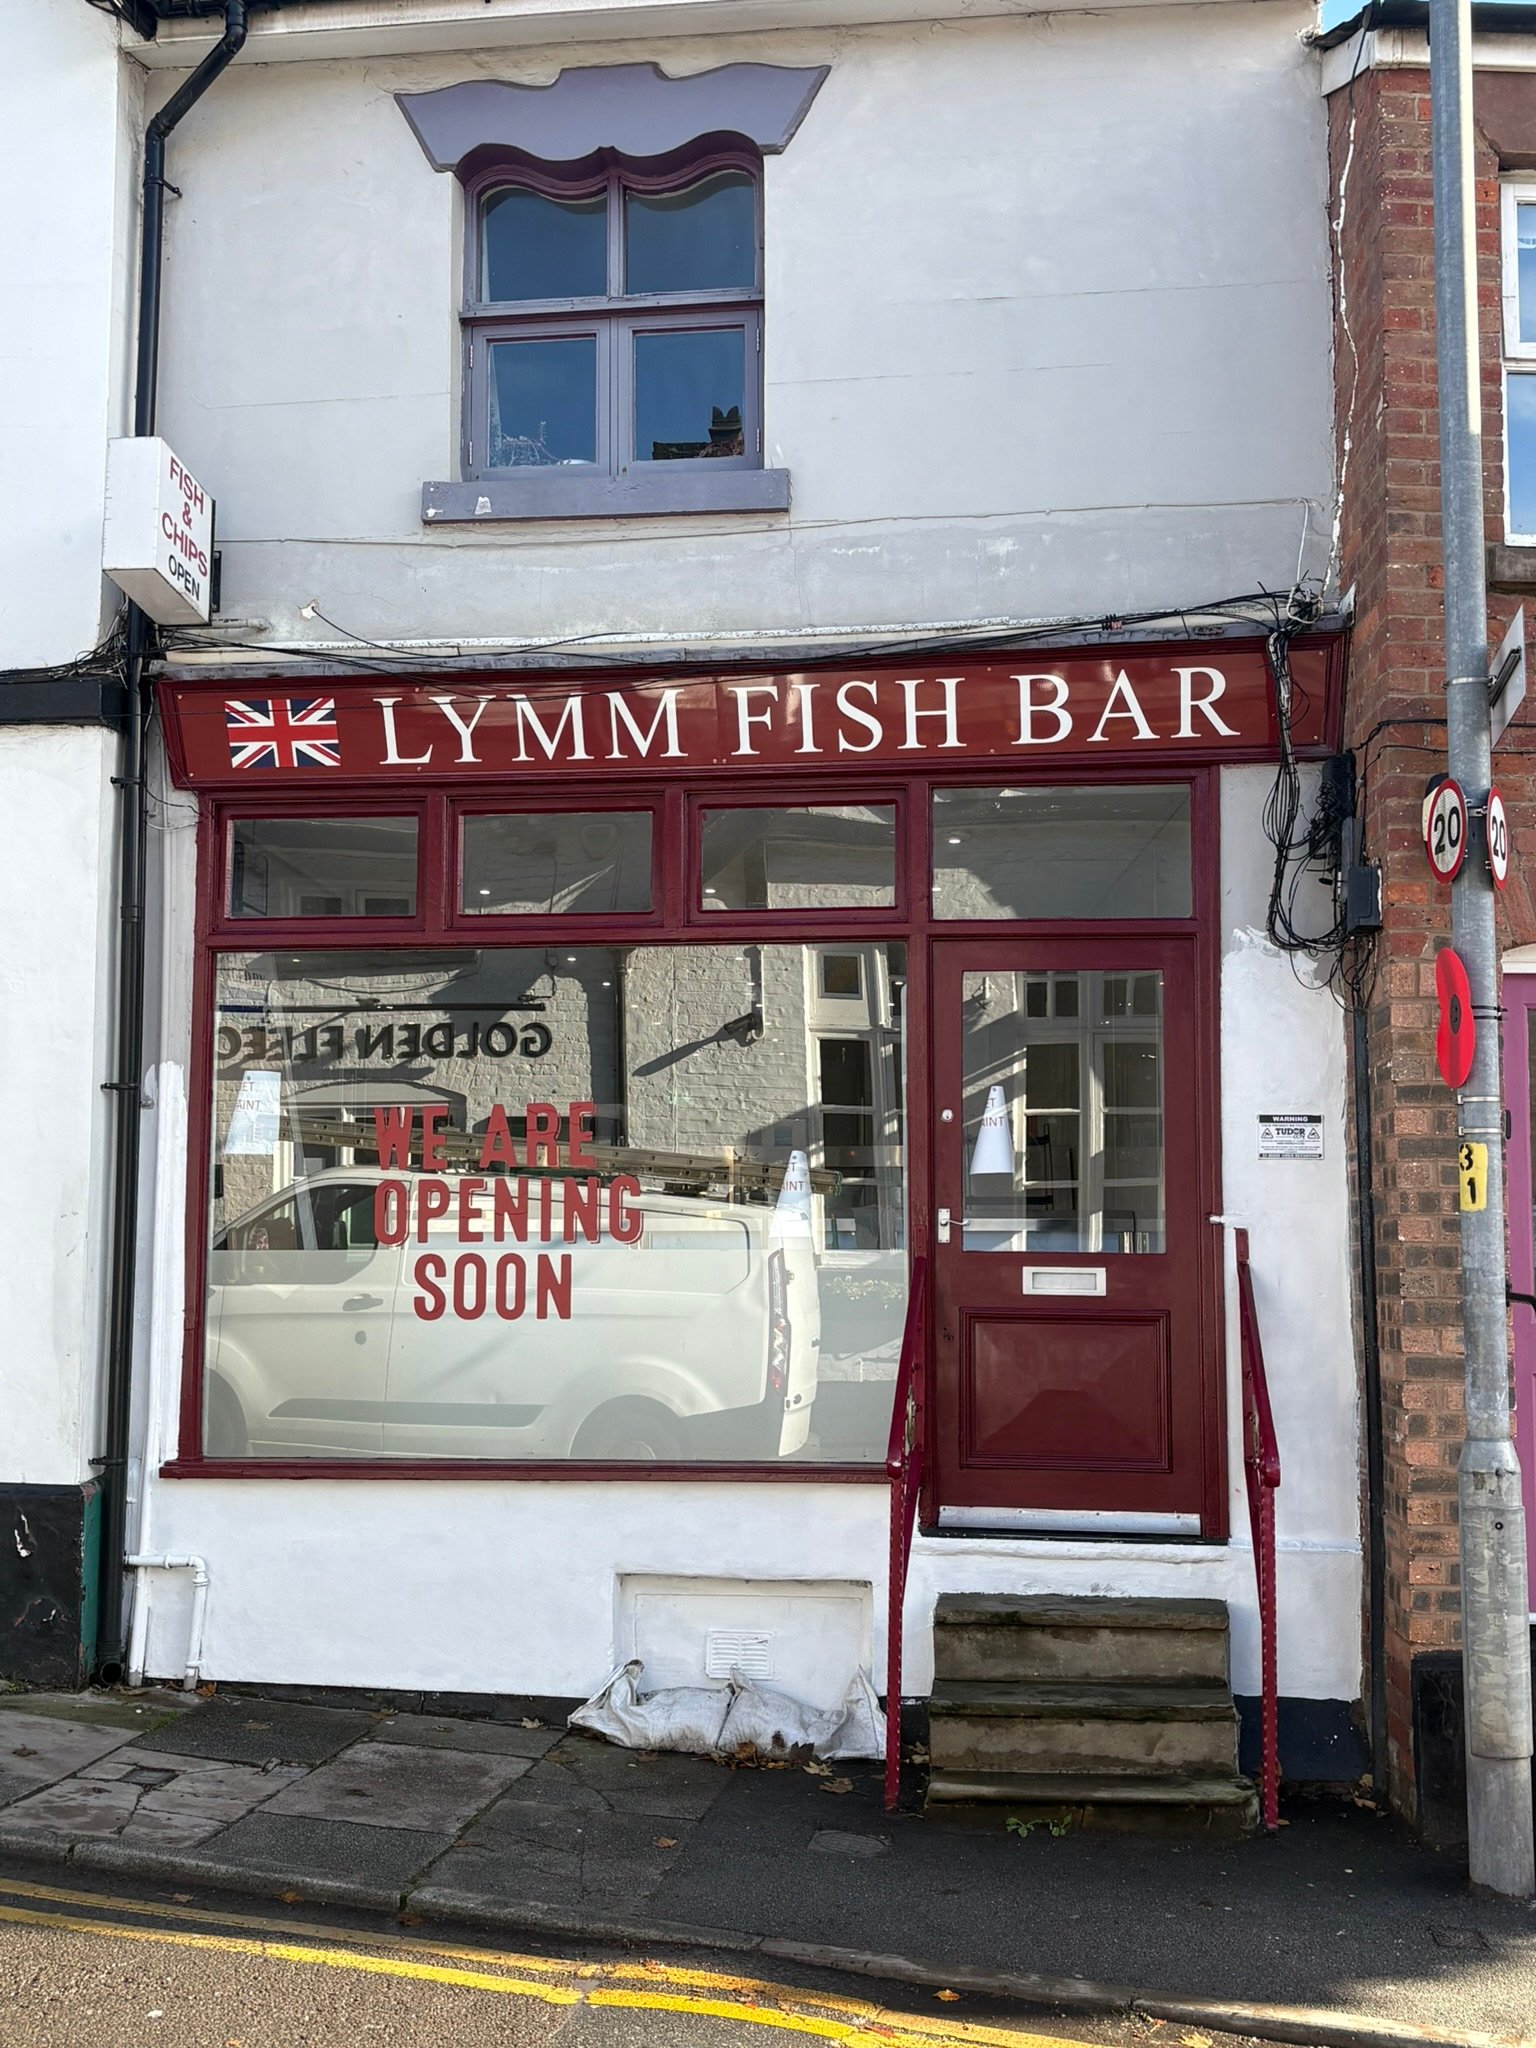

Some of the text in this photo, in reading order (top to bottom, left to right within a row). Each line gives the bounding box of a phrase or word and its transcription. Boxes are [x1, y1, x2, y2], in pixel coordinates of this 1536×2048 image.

[170, 456, 204, 515] FISH
[162, 512, 208, 577] CHIPS
[182, 502, 192, 530] &
[168, 555, 200, 601] OPEN
[373, 667, 1241, 765] LYMM FISH BAR
[1434, 806, 1460, 855] 20
[1491, 815, 1506, 861] 20
[374, 1101, 597, 1170] WE ARE
[1275, 1128, 1305, 1136] TUDOR
[374, 1175, 644, 1246] OPENING
[413, 1252, 572, 1321] SOON
